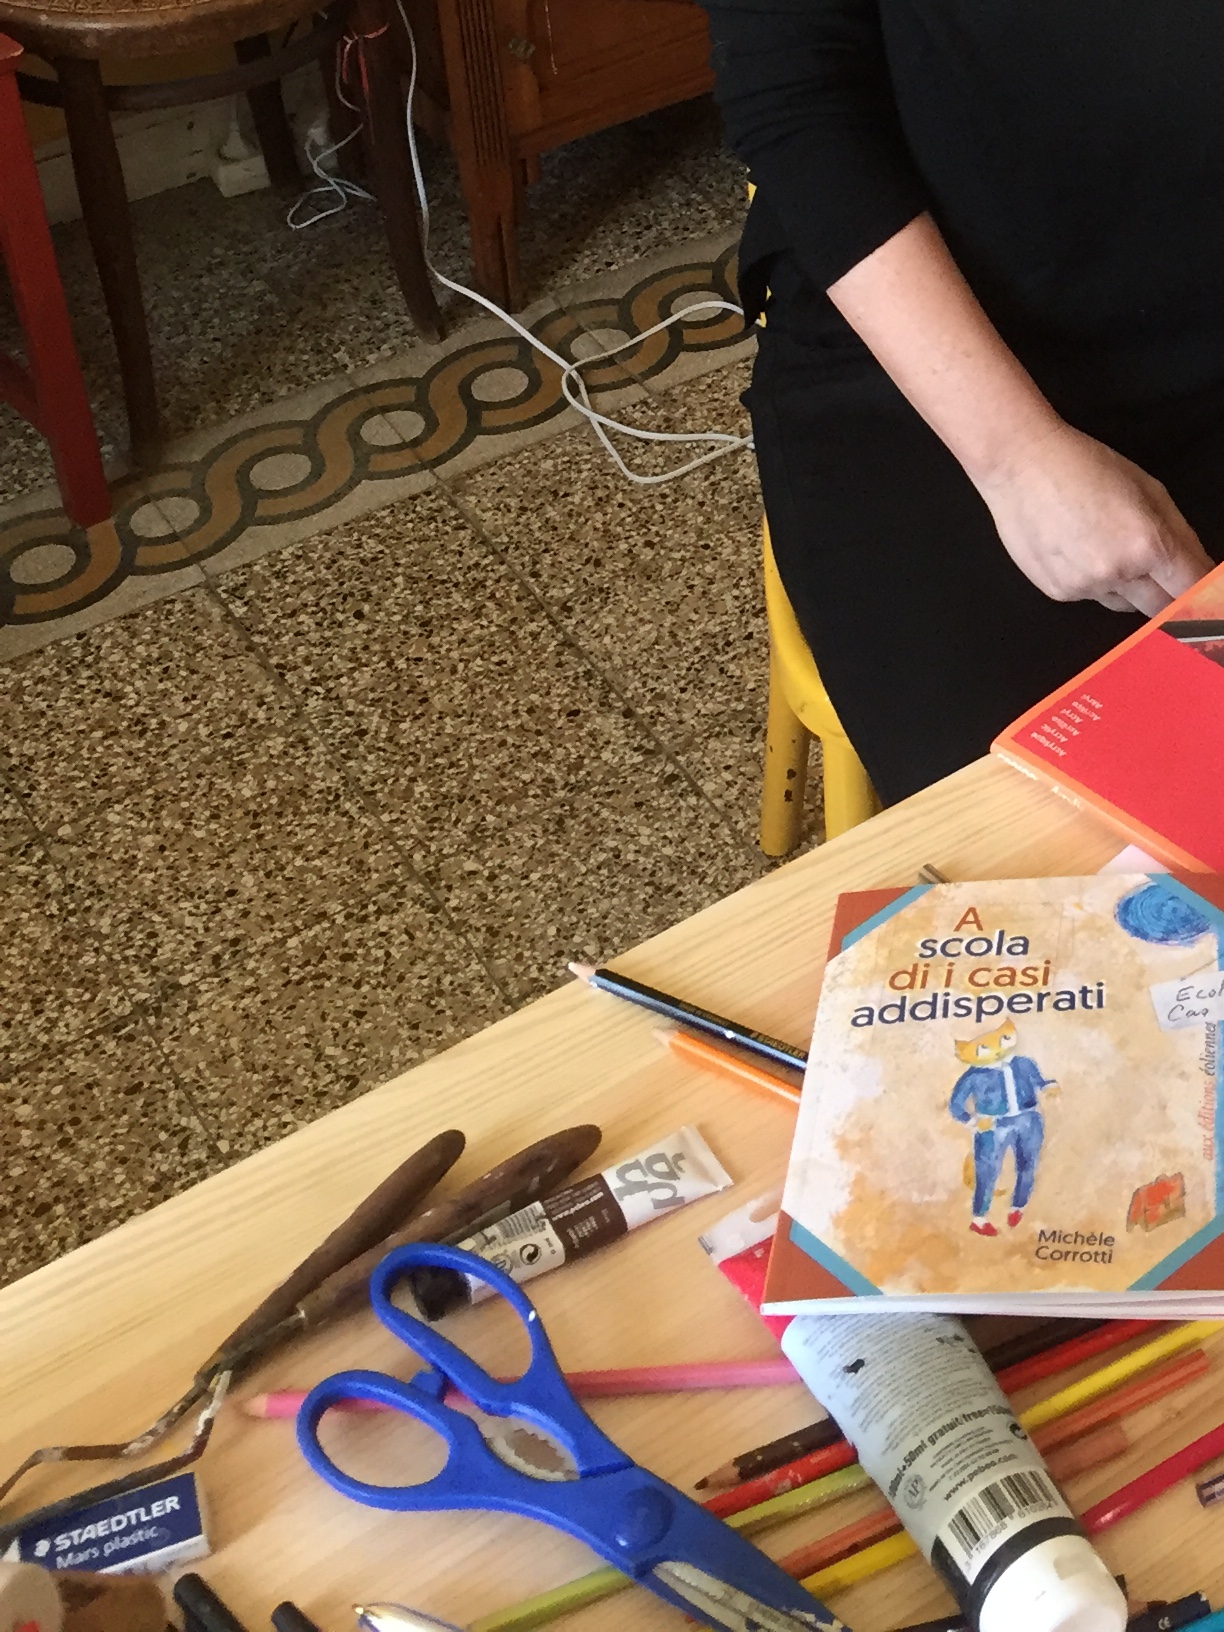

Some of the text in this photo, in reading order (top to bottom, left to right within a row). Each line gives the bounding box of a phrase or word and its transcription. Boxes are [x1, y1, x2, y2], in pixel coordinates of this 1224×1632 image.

[1059, 705, 1084, 725] Acryl
[1039, 721, 1069, 745] Acrylic
[953, 906, 984, 932] A
[918, 929, 1030, 959] scola
[889, 959, 1052, 991] di i casi
[850, 981, 1105, 1028] addisperati
[1199, 1079, 1216, 1128] éditions
[1203, 1137, 1214, 1161] aux
[1038, 1229, 1116, 1247] Michèle
[1035, 1245, 1113, 1264] Corrotti
[53, 1495, 182, 1553] STAEDTLER
[55, 1525, 160, 1570] Mars plastic
